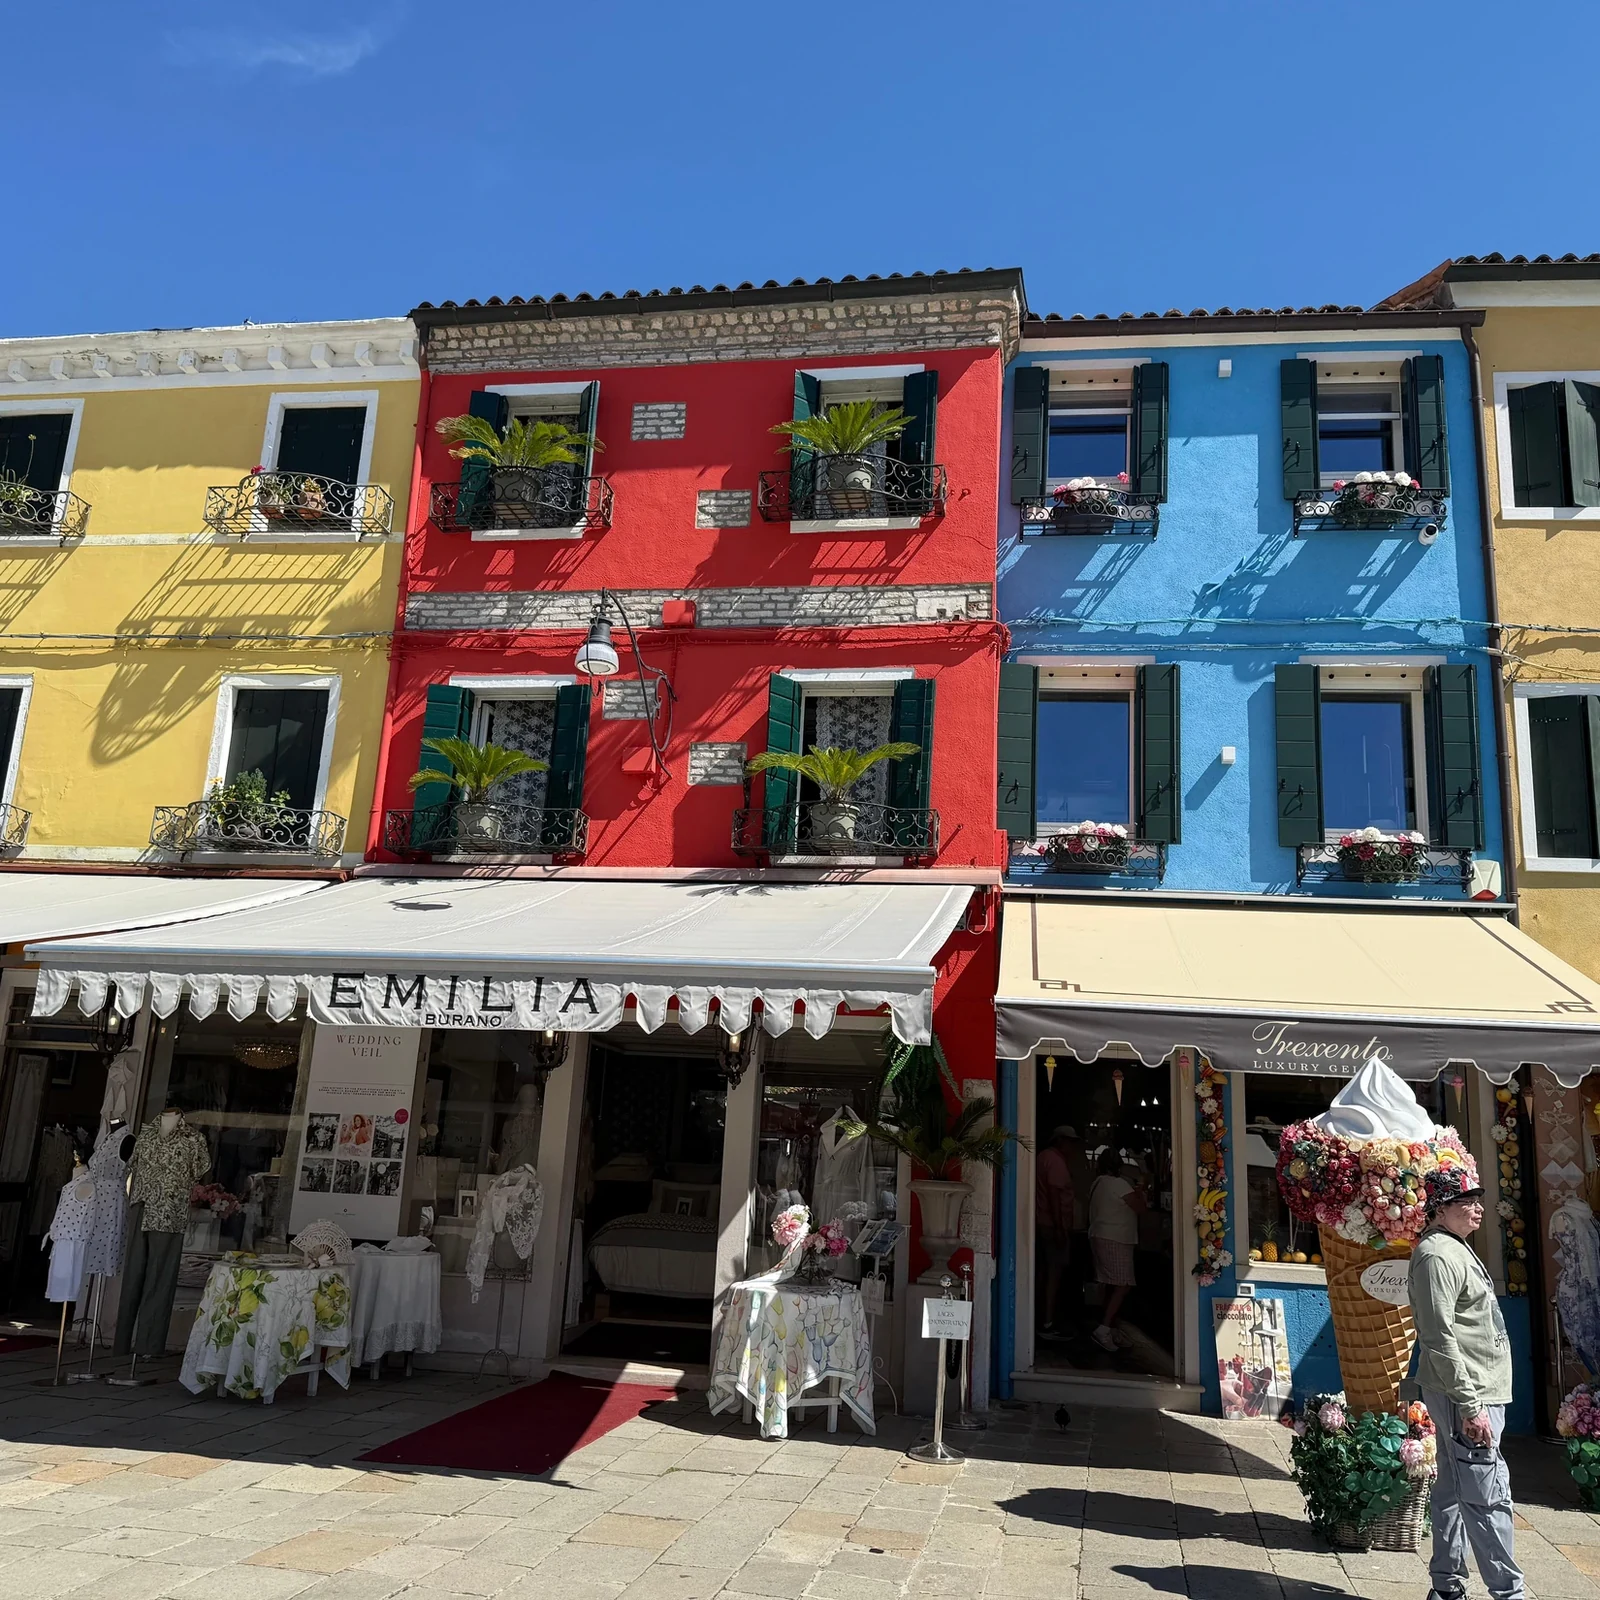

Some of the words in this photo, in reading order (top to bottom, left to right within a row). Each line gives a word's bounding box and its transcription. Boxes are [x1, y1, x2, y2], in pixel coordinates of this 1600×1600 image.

[327, 971, 599, 1014] EMILIA
[425, 1013, 502, 1027] BURANO
[336, 1034, 402, 1046] WEDDING
[1252, 1021, 1390, 1060] Trexento
[352, 1047, 382, 1058] VEIL
[1253, 1060, 1320, 1072] LUXURY
